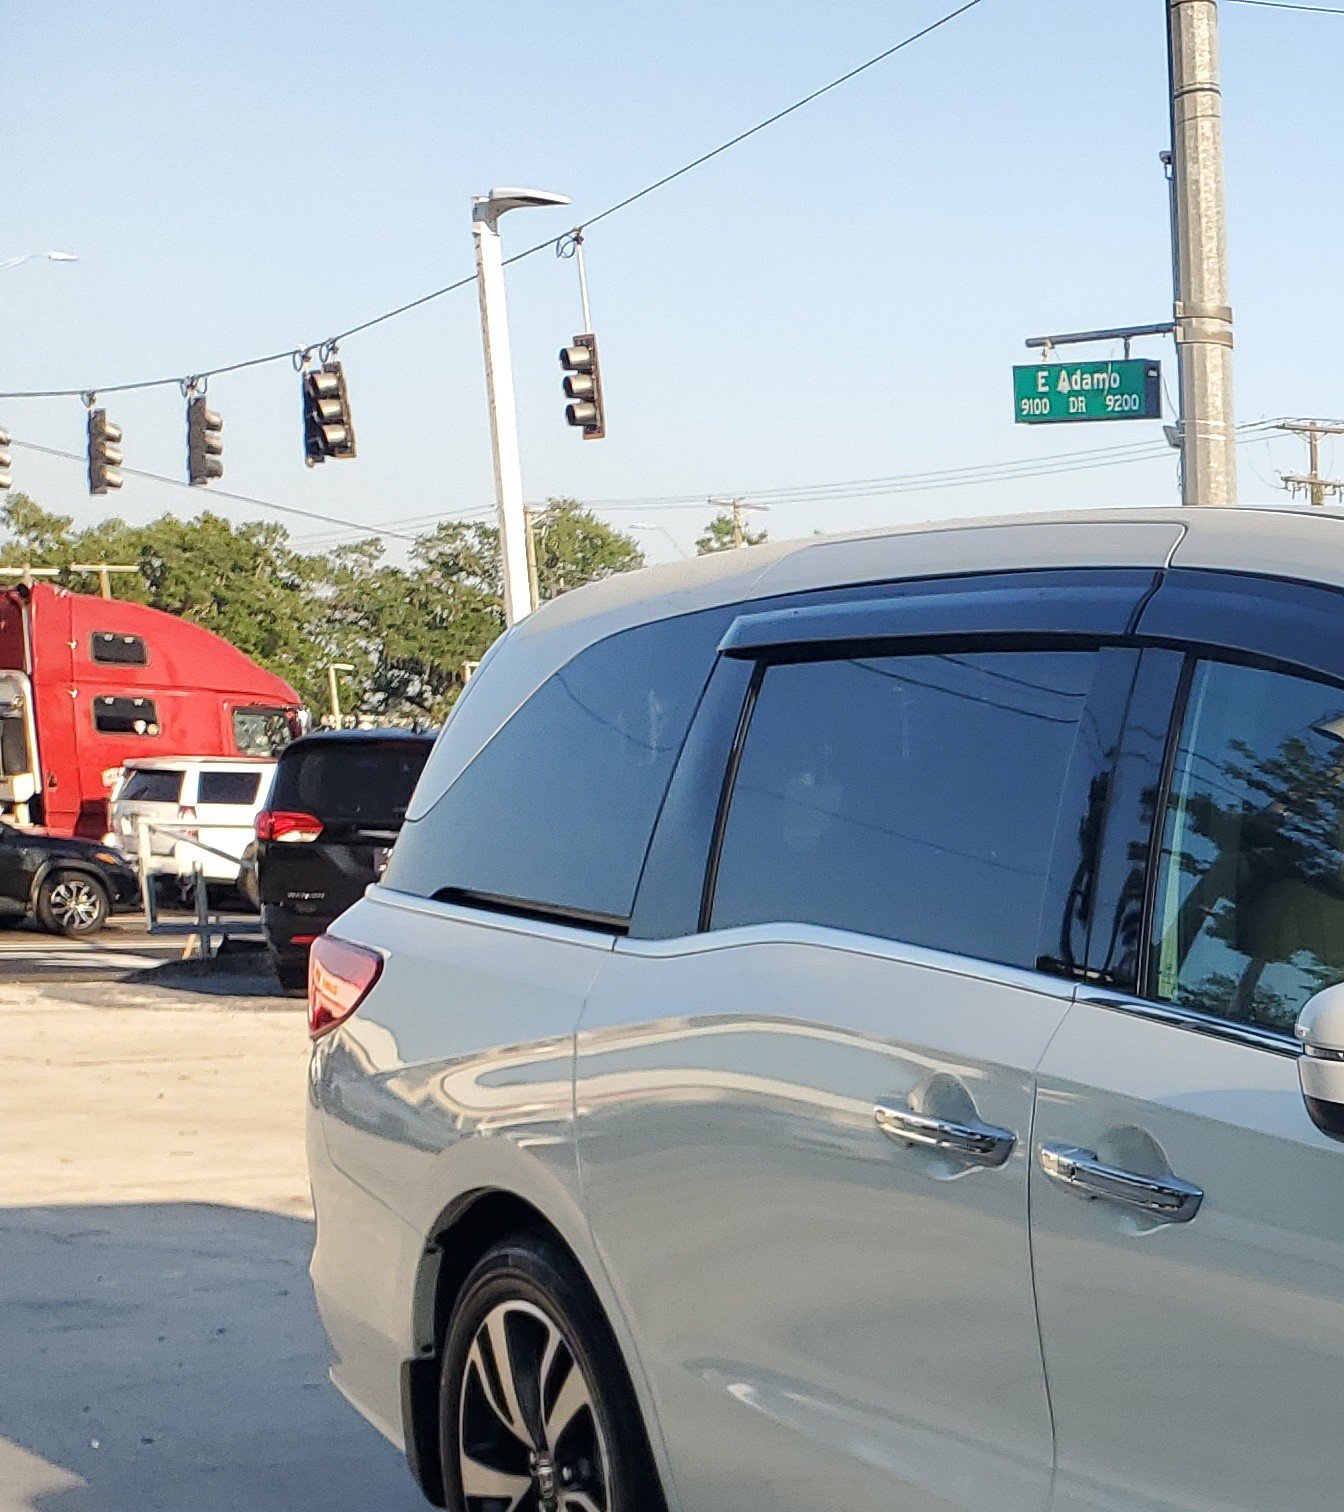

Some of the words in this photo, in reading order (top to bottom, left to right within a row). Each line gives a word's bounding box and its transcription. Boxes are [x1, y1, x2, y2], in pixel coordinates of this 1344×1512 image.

[1037, 370, 1050, 393] E
[1021, 397, 1050, 415] 9100
[1068, 396, 1087, 413] DR
[1105, 393, 1140, 412] 9200
